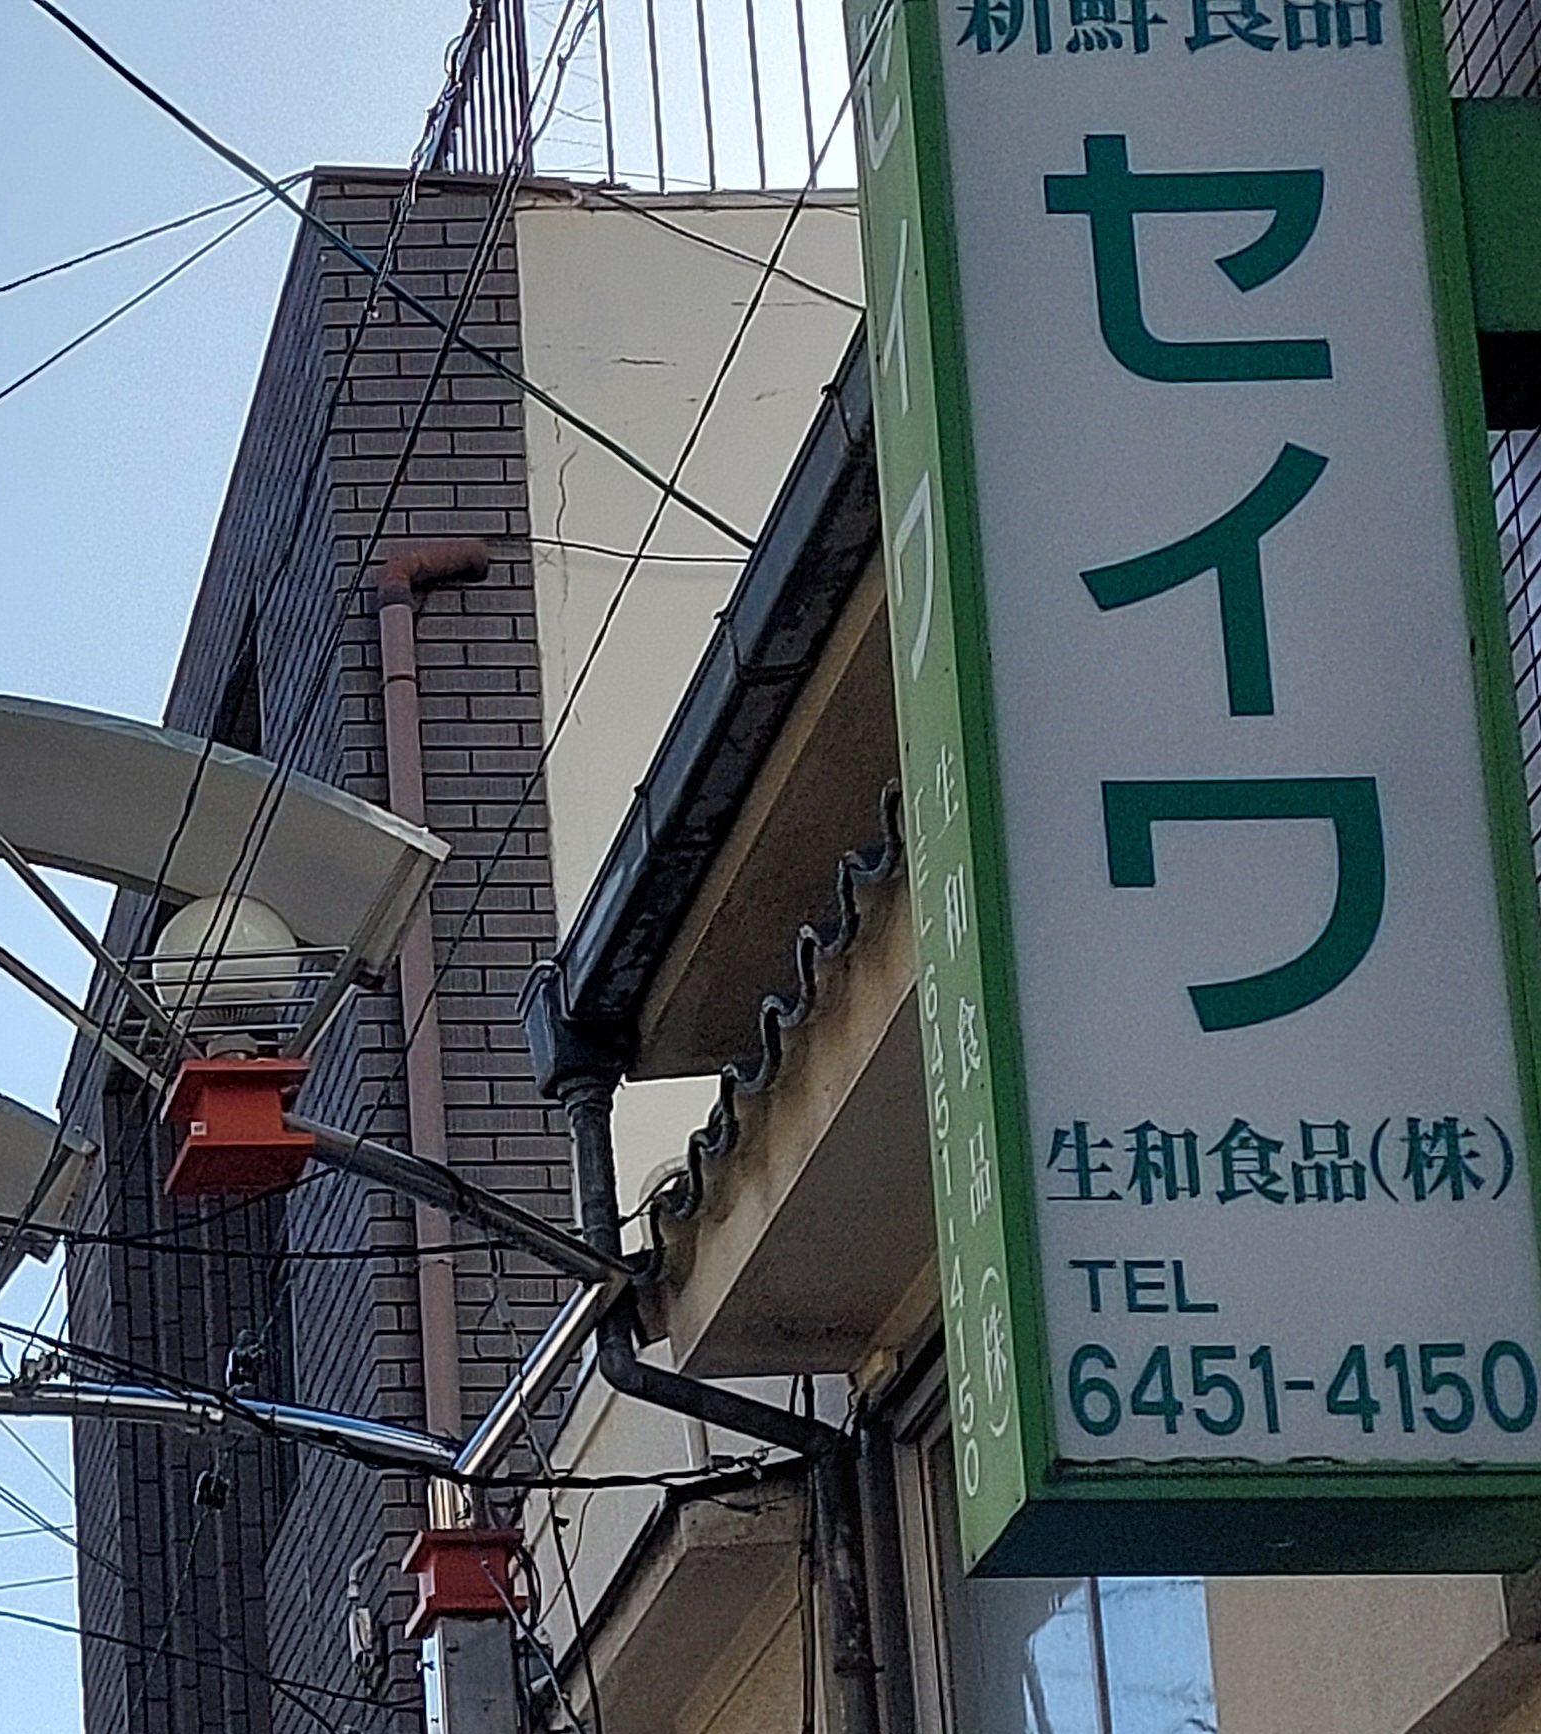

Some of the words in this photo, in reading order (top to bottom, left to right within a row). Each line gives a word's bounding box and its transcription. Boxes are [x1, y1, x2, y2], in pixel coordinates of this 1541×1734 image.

[1044, 133, 1386, 1032] セイワ
[1046, 1115, 1514, 1206] 生和食品(株)
[1069, 1259, 1218, 1314] TEL
[1068, 1339, 1537, 1436] 6451-4150
